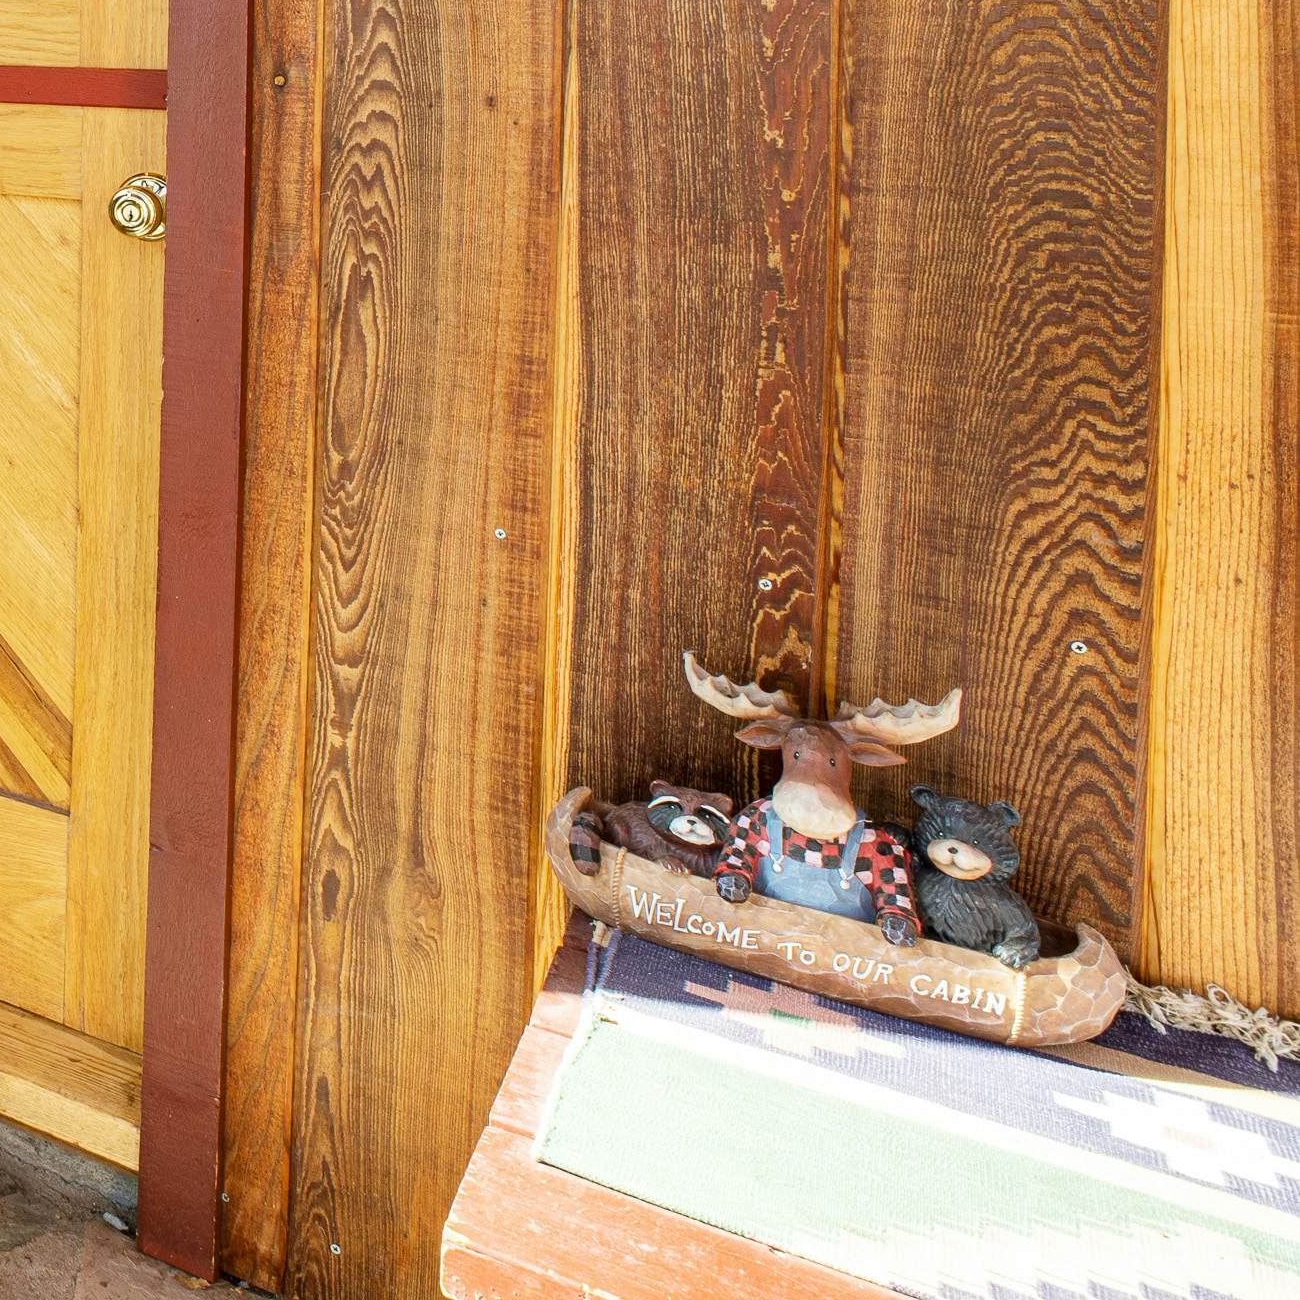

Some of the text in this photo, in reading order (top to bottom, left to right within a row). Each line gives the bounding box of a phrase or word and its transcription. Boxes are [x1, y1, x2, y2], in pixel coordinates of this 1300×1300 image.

[626, 884, 761, 949] WELCOME
[832, 953, 894, 985] OUR
[910, 974, 1007, 1016] CABIN
